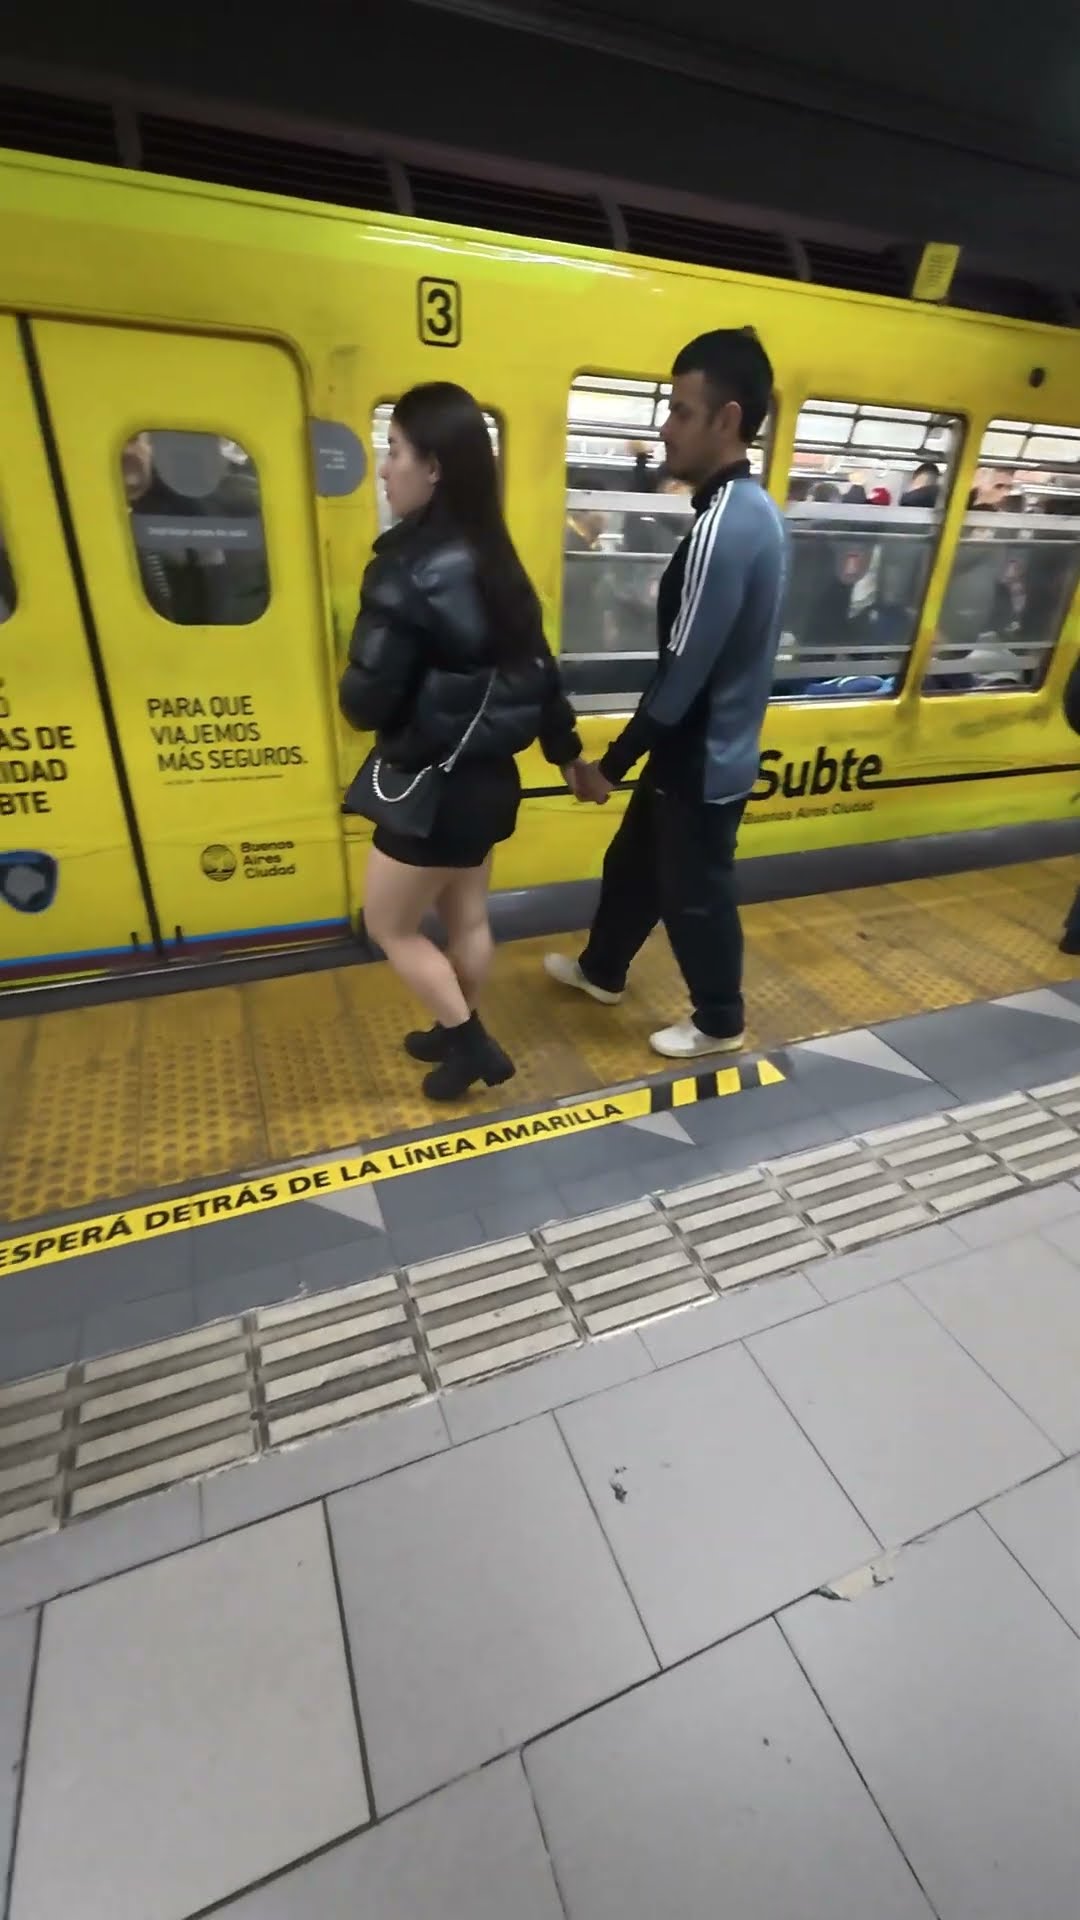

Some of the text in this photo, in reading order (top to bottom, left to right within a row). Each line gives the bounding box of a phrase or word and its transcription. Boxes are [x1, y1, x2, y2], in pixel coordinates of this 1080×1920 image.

[427, 287, 452, 337] 3
[147, 695, 255, 719] PARA QUE
[35, 725, 77, 750] DE
[150, 722, 261, 745] VIAJEMOS
[157, 746, 309, 771] MÁS SEGUROS.
[749, 746, 883, 801] Subte
[241, 841, 295, 853] Buenos
[243, 855, 282, 866] Aires
[244, 864, 296, 879] Ciudad
[145, 1185, 278, 1231] DETRÁS
[289, 1171, 332, 1195] DE
[341, 1160, 382, 1181] LA
[388, 1137, 476, 1170] LÍNEA
[484, 1102, 625, 1148] AMARILLA
